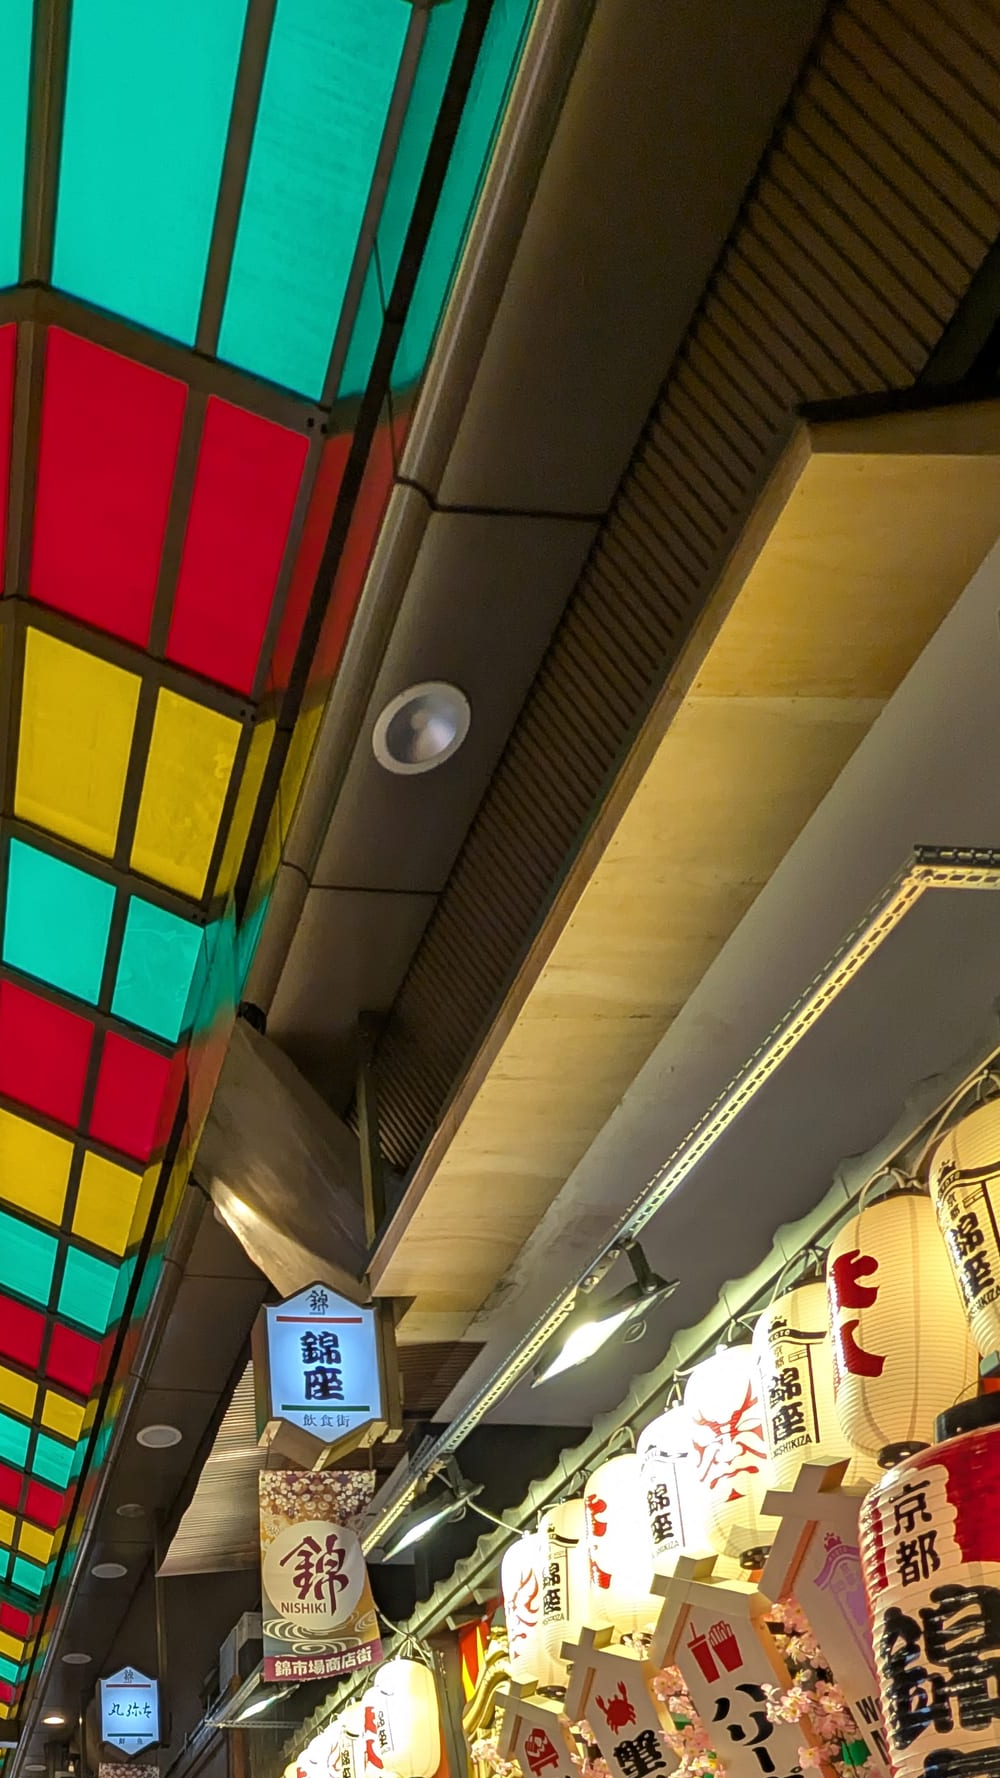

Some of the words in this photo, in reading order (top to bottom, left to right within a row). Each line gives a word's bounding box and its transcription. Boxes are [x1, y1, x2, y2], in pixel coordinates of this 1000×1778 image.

[305, 1289, 329, 1314] 錦
[300, 1330, 344, 1402] 錦座
[302, 1413, 350, 1429] 飲食街
[888, 1480, 941, 1587] 京都
[280, 1533, 350, 1617] 錦
[281, 1601, 327, 1615] NISHIKI
[274, 1646, 373, 1679] 錦市場商店街
